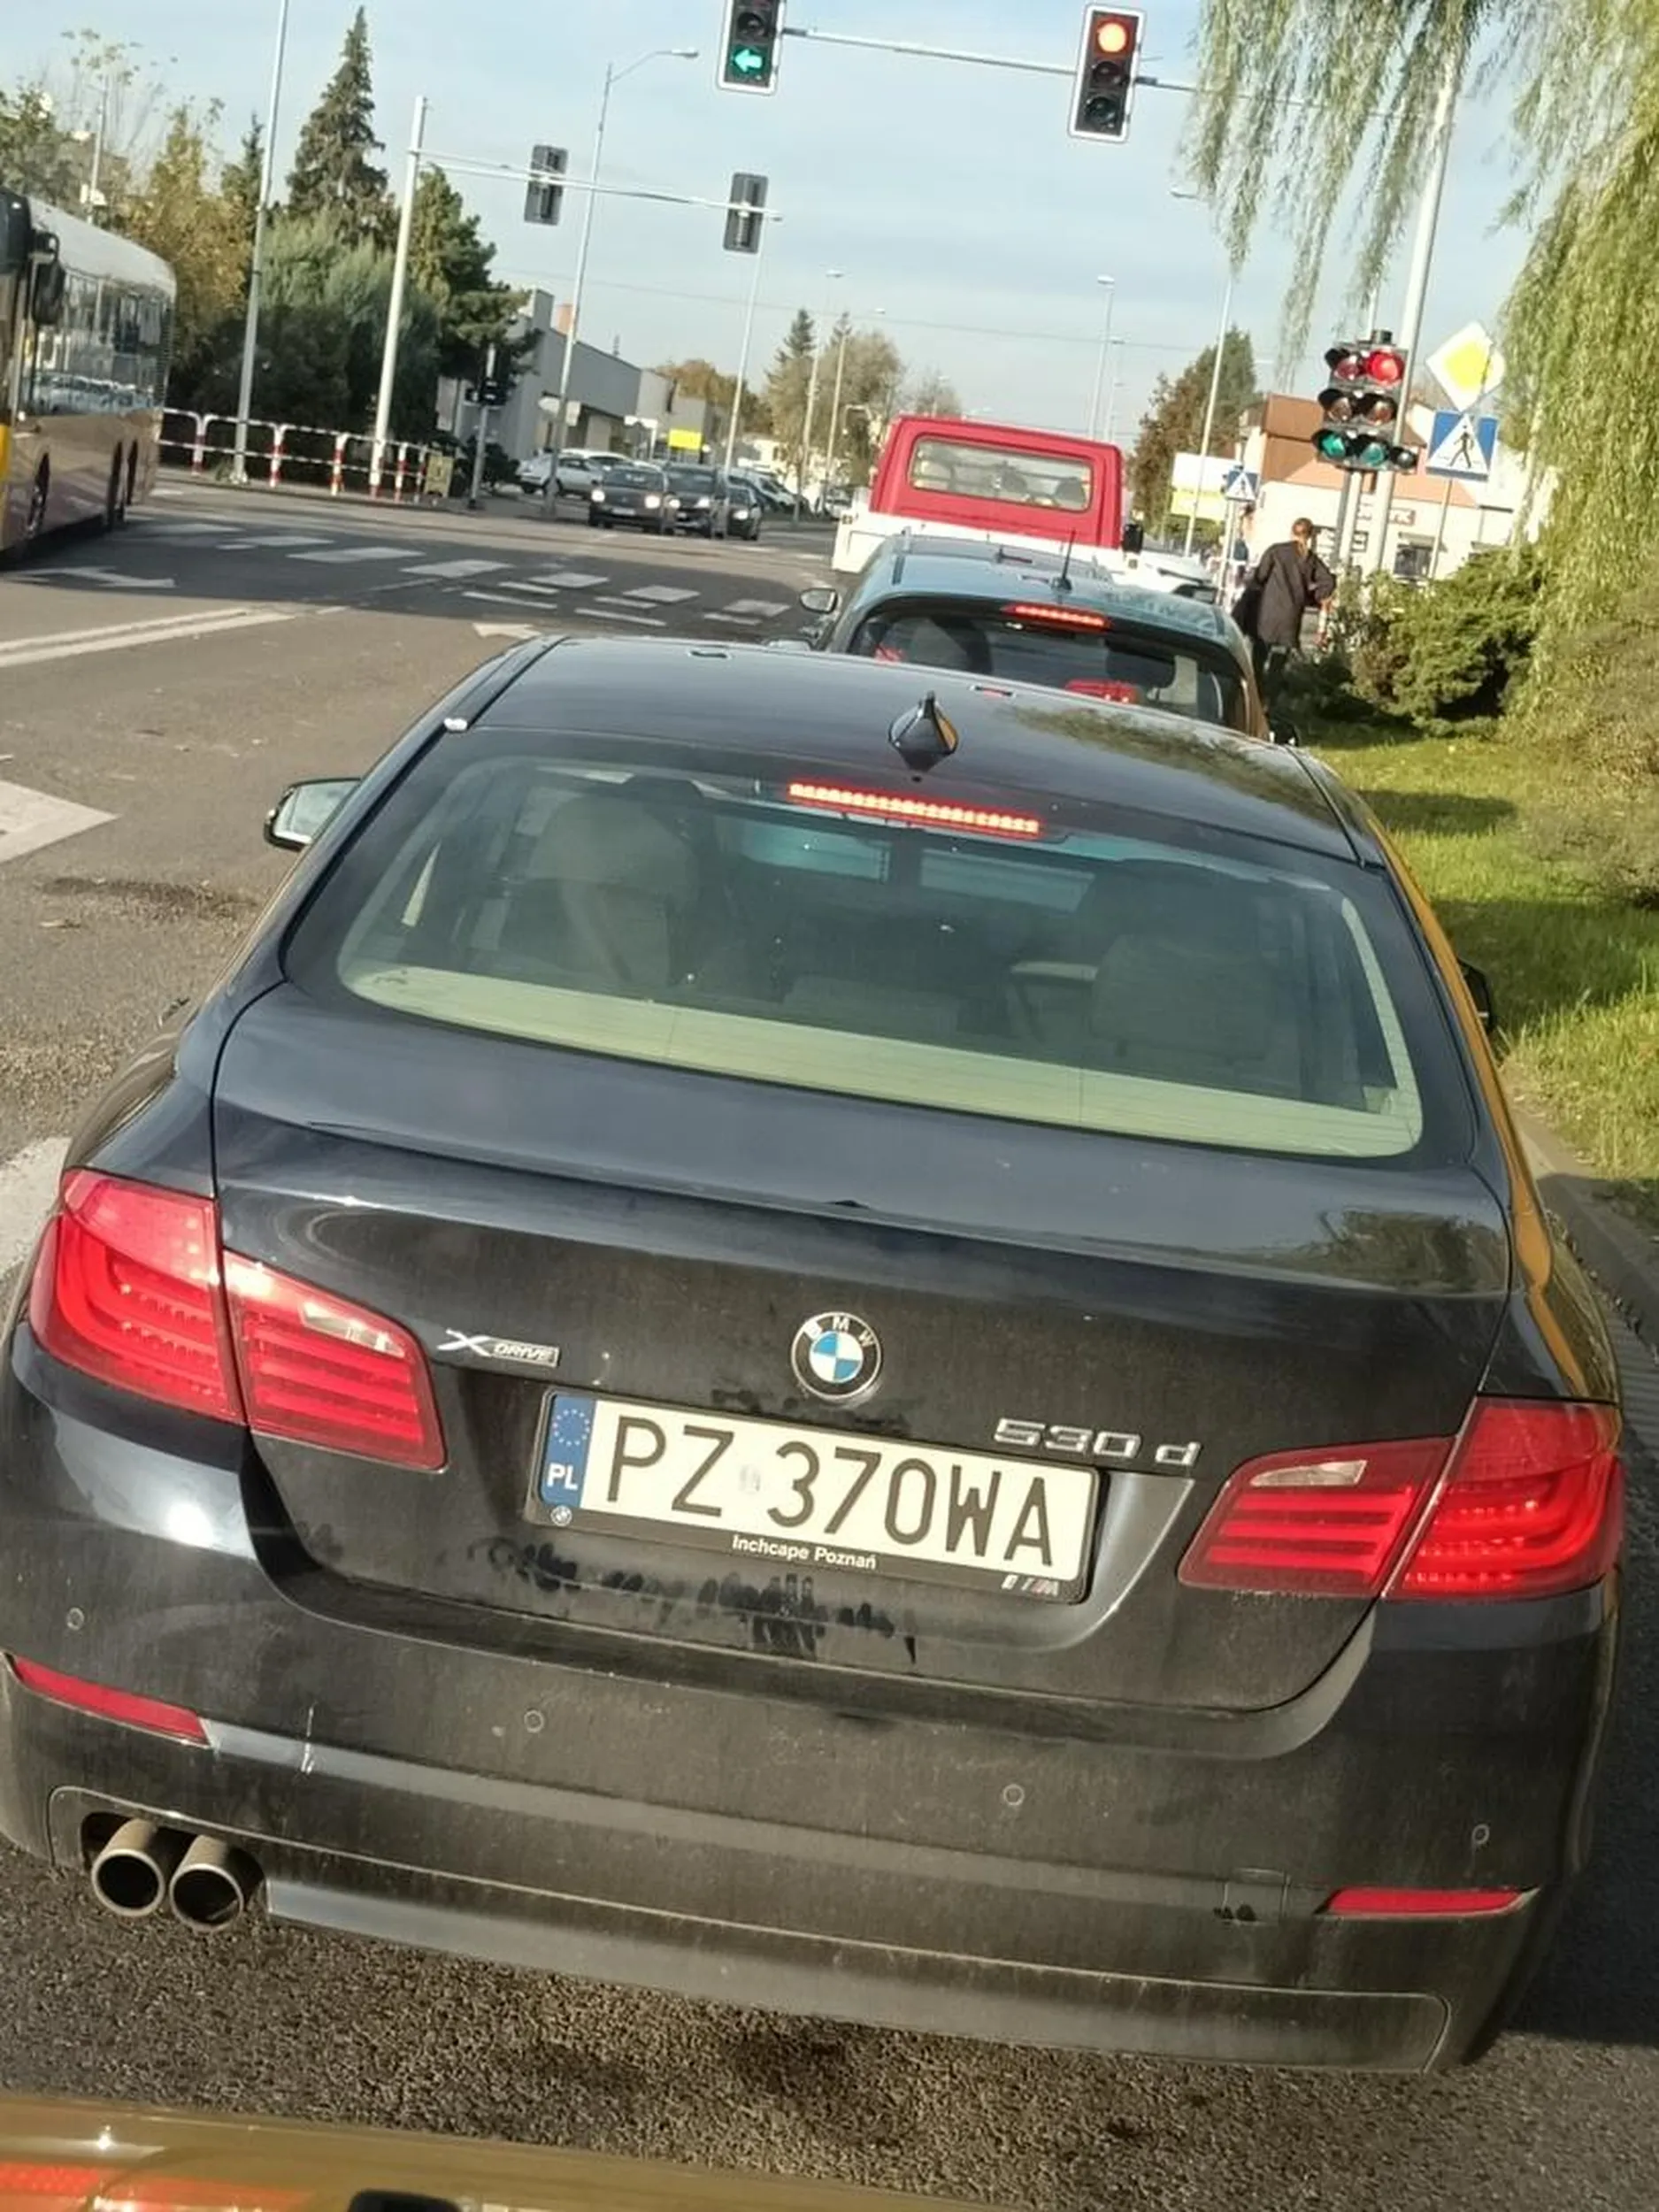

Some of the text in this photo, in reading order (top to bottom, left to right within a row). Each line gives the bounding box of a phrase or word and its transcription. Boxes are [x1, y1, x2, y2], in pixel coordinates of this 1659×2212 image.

[803, 1316, 875, 1347] BMW
[994, 1417, 1202, 1466] 530 d
[547, 1462, 578, 1491] PL
[607, 1415, 1054, 1567] PZ 370WA
[732, 1533, 876, 1571] Inchcape Poznań
